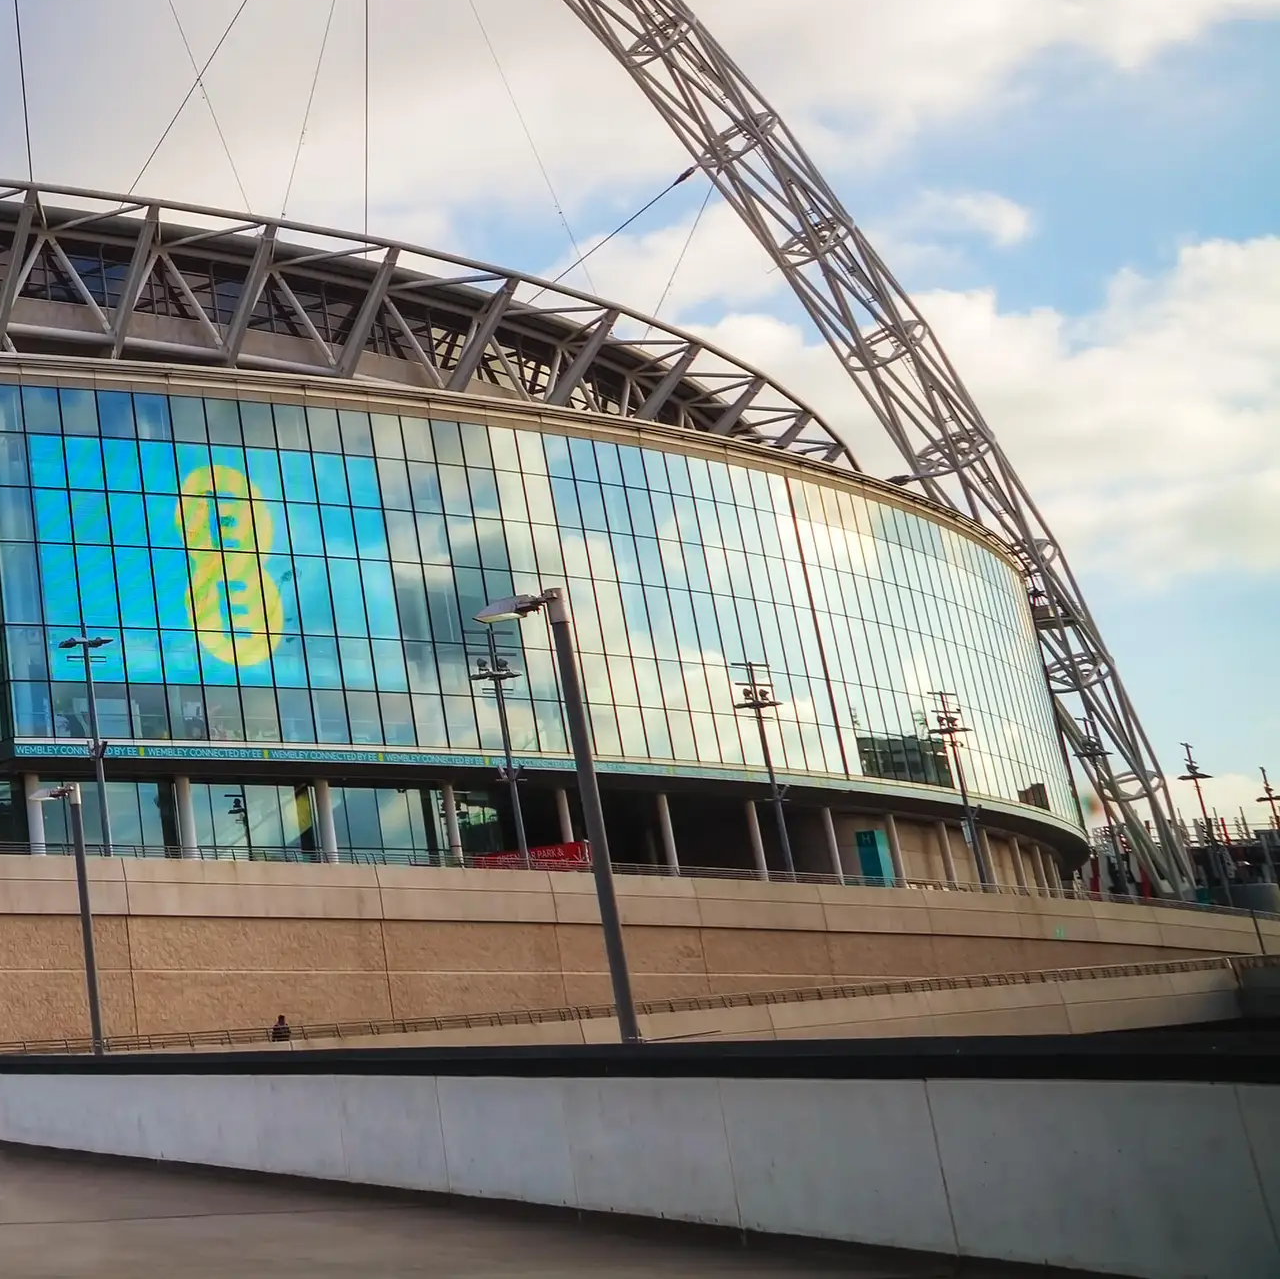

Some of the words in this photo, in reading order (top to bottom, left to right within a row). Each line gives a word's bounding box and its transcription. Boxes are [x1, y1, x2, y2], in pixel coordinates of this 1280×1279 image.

[16, 745, 61, 755] WEMBLEY
[114, 746, 126, 755] BY
[127, 747, 137, 756] EE
[148, 747, 188, 756] WEMBLEY
[190, 748, 240, 758] CONNECTED
[240, 749, 251, 757] BY
[252, 749, 262, 758] EE
[271, 750, 309, 759] WEMBLEY
[310, 751, 357, 761] CONNECTED
[357, 753, 367, 761] BY
[368, 753, 377, 761] EE
